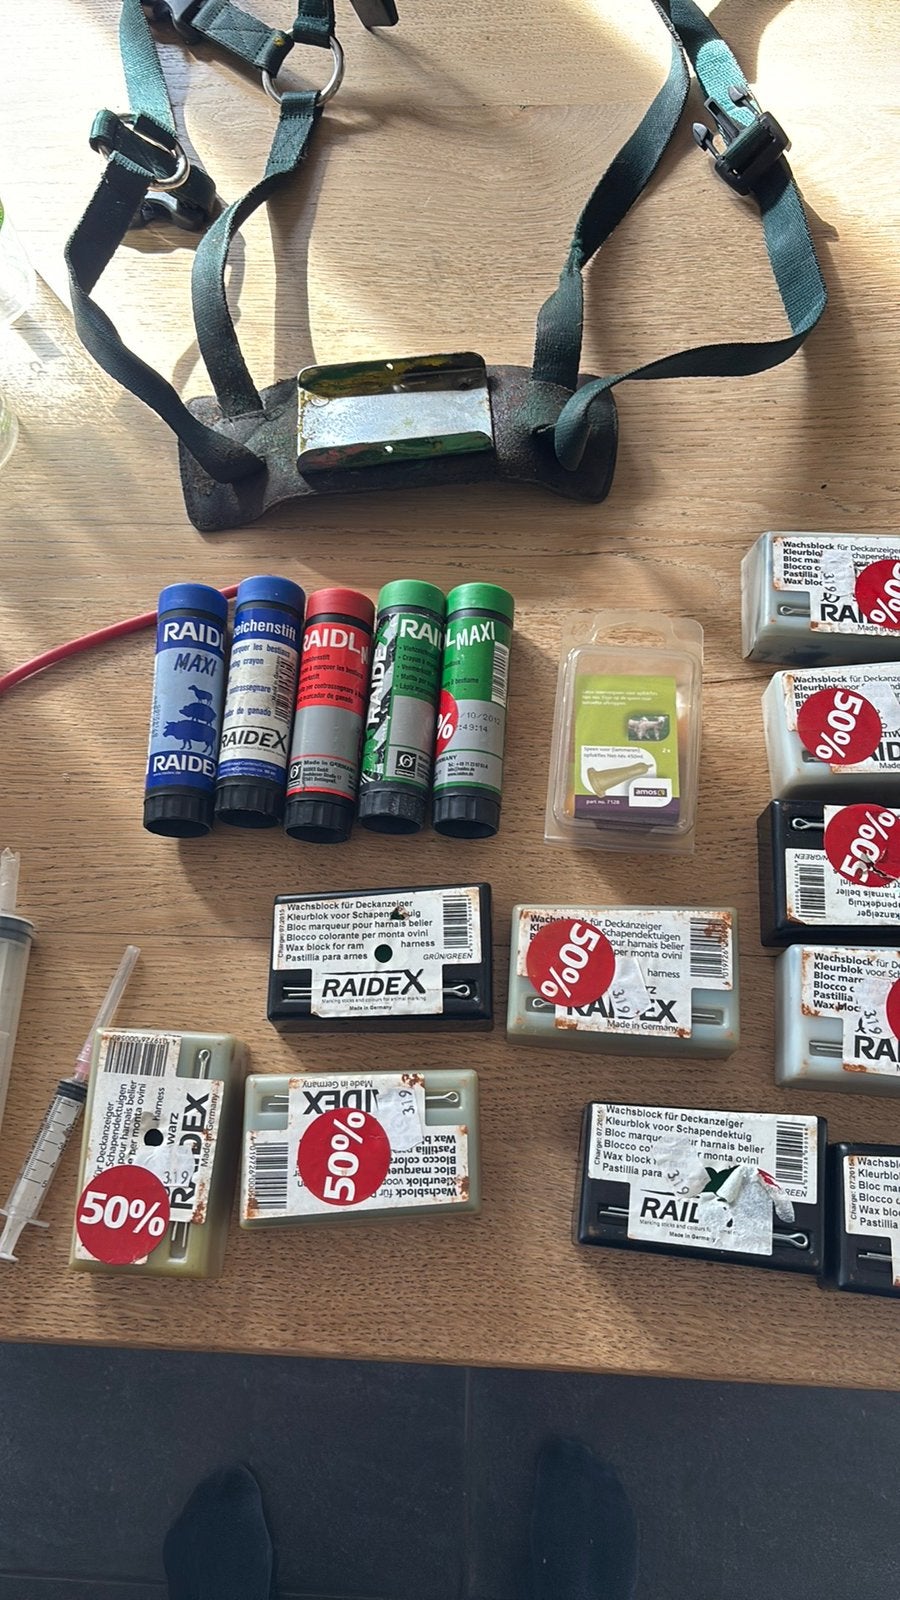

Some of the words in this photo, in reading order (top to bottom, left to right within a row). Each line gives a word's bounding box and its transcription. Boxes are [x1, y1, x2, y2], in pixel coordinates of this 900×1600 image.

[783, 541, 834, 550] Wachsblock
[783, 570, 818, 578] Pastillia
[253, 643, 263, 651] les
[173, 652, 217, 677] MAXI
[243, 658, 264, 666] crayon
[793, 675, 847, 683] Wachsblock
[237, 706, 244, 714] de
[247, 707, 271, 716] ganado
[815, 690, 864, 760] 50%
[221, 730, 287, 754] RAIDEX
[153, 754, 216, 778] RAIDE
[840, 811, 895, 883] 50%
[836, 889, 861, 897] belier
[863, 890, 896, 899] harnais
[287, 902, 339, 911] Wachsblock
[356, 900, 413, 910] Deckanzeiger
[287, 912, 329, 921] Kleurblok
[309, 922, 350, 931] marqueur
[352, 922, 372, 930] pour
[374, 920, 406, 928] harnais
[590, 918, 602, 926] für
[605, 919, 662, 931] Deckanzeiger
[287, 933, 317, 941] Blocco
[319, 932, 359, 940] colorante
[362, 932, 375, 940] per
[377, 930, 405, 938] monta
[407, 929, 428, 937] ovini
[602, 928, 680, 941] Schapendektuigen
[307, 943, 330, 951] block
[332, 942, 345, 950] for
[400, 940, 435, 948] harness
[627, 939, 658, 949] harnais
[660, 942, 685, 950] belier
[322, 954, 341, 962] para
[540, 922, 600, 998] 50%
[630, 949, 659, 958] monta
[662, 951, 682, 960] ovini
[813, 952, 873, 966] Wachsblock
[876, 959, 888, 967] für
[647, 968, 680, 978] harness
[813, 962, 863, 975] Kleurblok
[865, 968, 885, 977] voor
[813, 971, 836, 981] Bloc
[322, 968, 426, 998] RAIDEX
[813, 981, 847, 992] Blocco
[813, 990, 853, 1002] Pastillia
[813, 1000, 835, 1009] Wax
[607, 1020, 631, 1029] Made
[632, 1021, 639, 1029] in
[641, 1022, 679, 1032] Germany
[302, 1080, 339, 1089] Germany
[341, 1080, 349, 1089] in
[350, 1080, 373, 1088] Made
[125, 1080, 137, 1106] belier
[138, 1083, 147, 1105] ovini
[152, 1087, 165, 1121] harness
[205, 1093, 220, 1131] Germany
[606, 1105, 663, 1120] Wachsblock
[664, 1112, 679, 1121] für
[680, 1113, 744, 1129] Deckanzeiger
[105, 1083, 127, 1167] Schapendektuigen
[120, 1107, 133, 1140] harnais
[132, 1108, 143, 1138] monta
[96, 1102, 114, 1163] Deckanzeiger
[605, 1117, 650, 1130] Kleurblok
[652, 1123, 674, 1132] voor
[676, 1124, 752, 1142] Schapendektuig
[434, 1135, 456, 1143] Wax
[604, 1128, 626, 1138] Bloc
[700, 1139, 735, 1150] harnais
[738, 1144, 765, 1154] belier
[58, 1142, 64, 1150] 3
[129, 1139, 138, 1157] per
[416, 1145, 456, 1155] Pastillia
[594, 1138, 602, 1165] Charge:
[118, 1144, 126, 1165] pour
[200, 1144, 211, 1167] Made
[323, 1111, 365, 1201] 50%
[603, 1151, 623, 1161] Wax
[625, 1154, 651, 1165] block
[604, 1140, 637, 1151] Blocco
[703, 1153, 733, 1162] monta
[736, 1156, 760, 1165] ovini
[422, 1156, 456, 1164] Blocco
[434, 1166, 456, 1175] Bloc
[641, 1168, 663, 1178] para
[41, 1180, 48, 1188] 5
[406, 1177, 456, 1187] Kleurblok
[859, 1181, 880, 1190] Bloc
[378, 1189, 393, 1198] für
[396, 1187, 457, 1197] Wachsblock
[859, 1193, 893, 1204] Blocco
[80, 1190, 165, 1236] 50%
[859, 1205, 880, 1215] Wax
[860, 1217, 899, 1229] Pastillia
